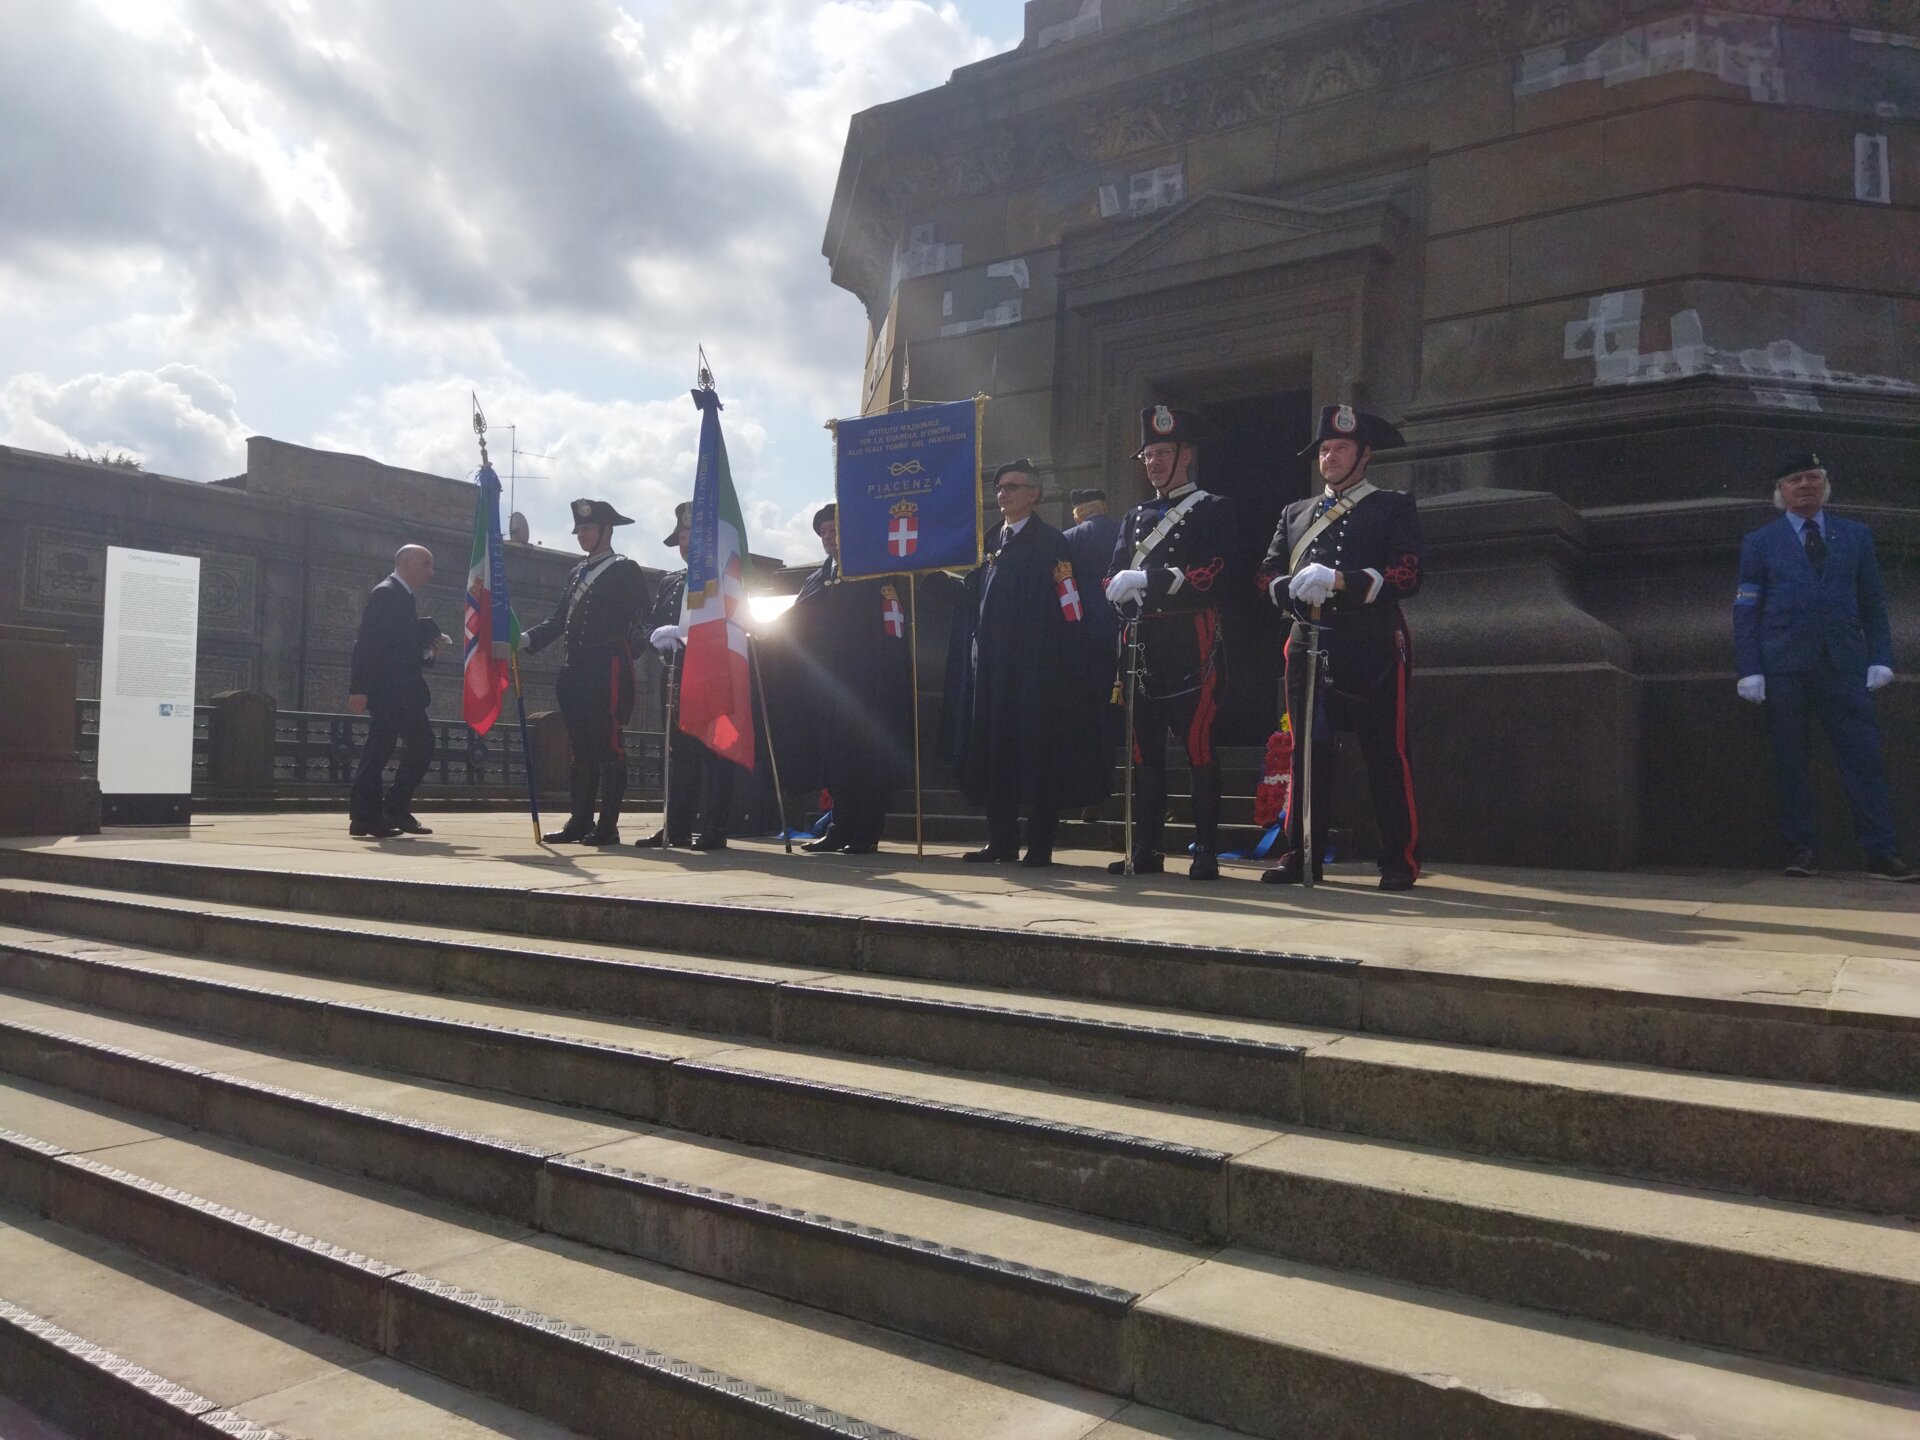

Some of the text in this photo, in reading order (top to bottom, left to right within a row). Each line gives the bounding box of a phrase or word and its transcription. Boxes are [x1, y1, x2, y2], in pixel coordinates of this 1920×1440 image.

[859, 438, 871, 446] PER
[886, 432, 918, 443] GUARDIA
[920, 425, 953, 437] D'ONORE
[868, 418, 940, 436] ISTITUTO NAZIONALE
[847, 448, 863, 457] ALLE
[886, 441, 908, 452] TOMBE
[928, 431, 967, 444] PANTHEON
[867, 476, 943, 495] PIACENZA
